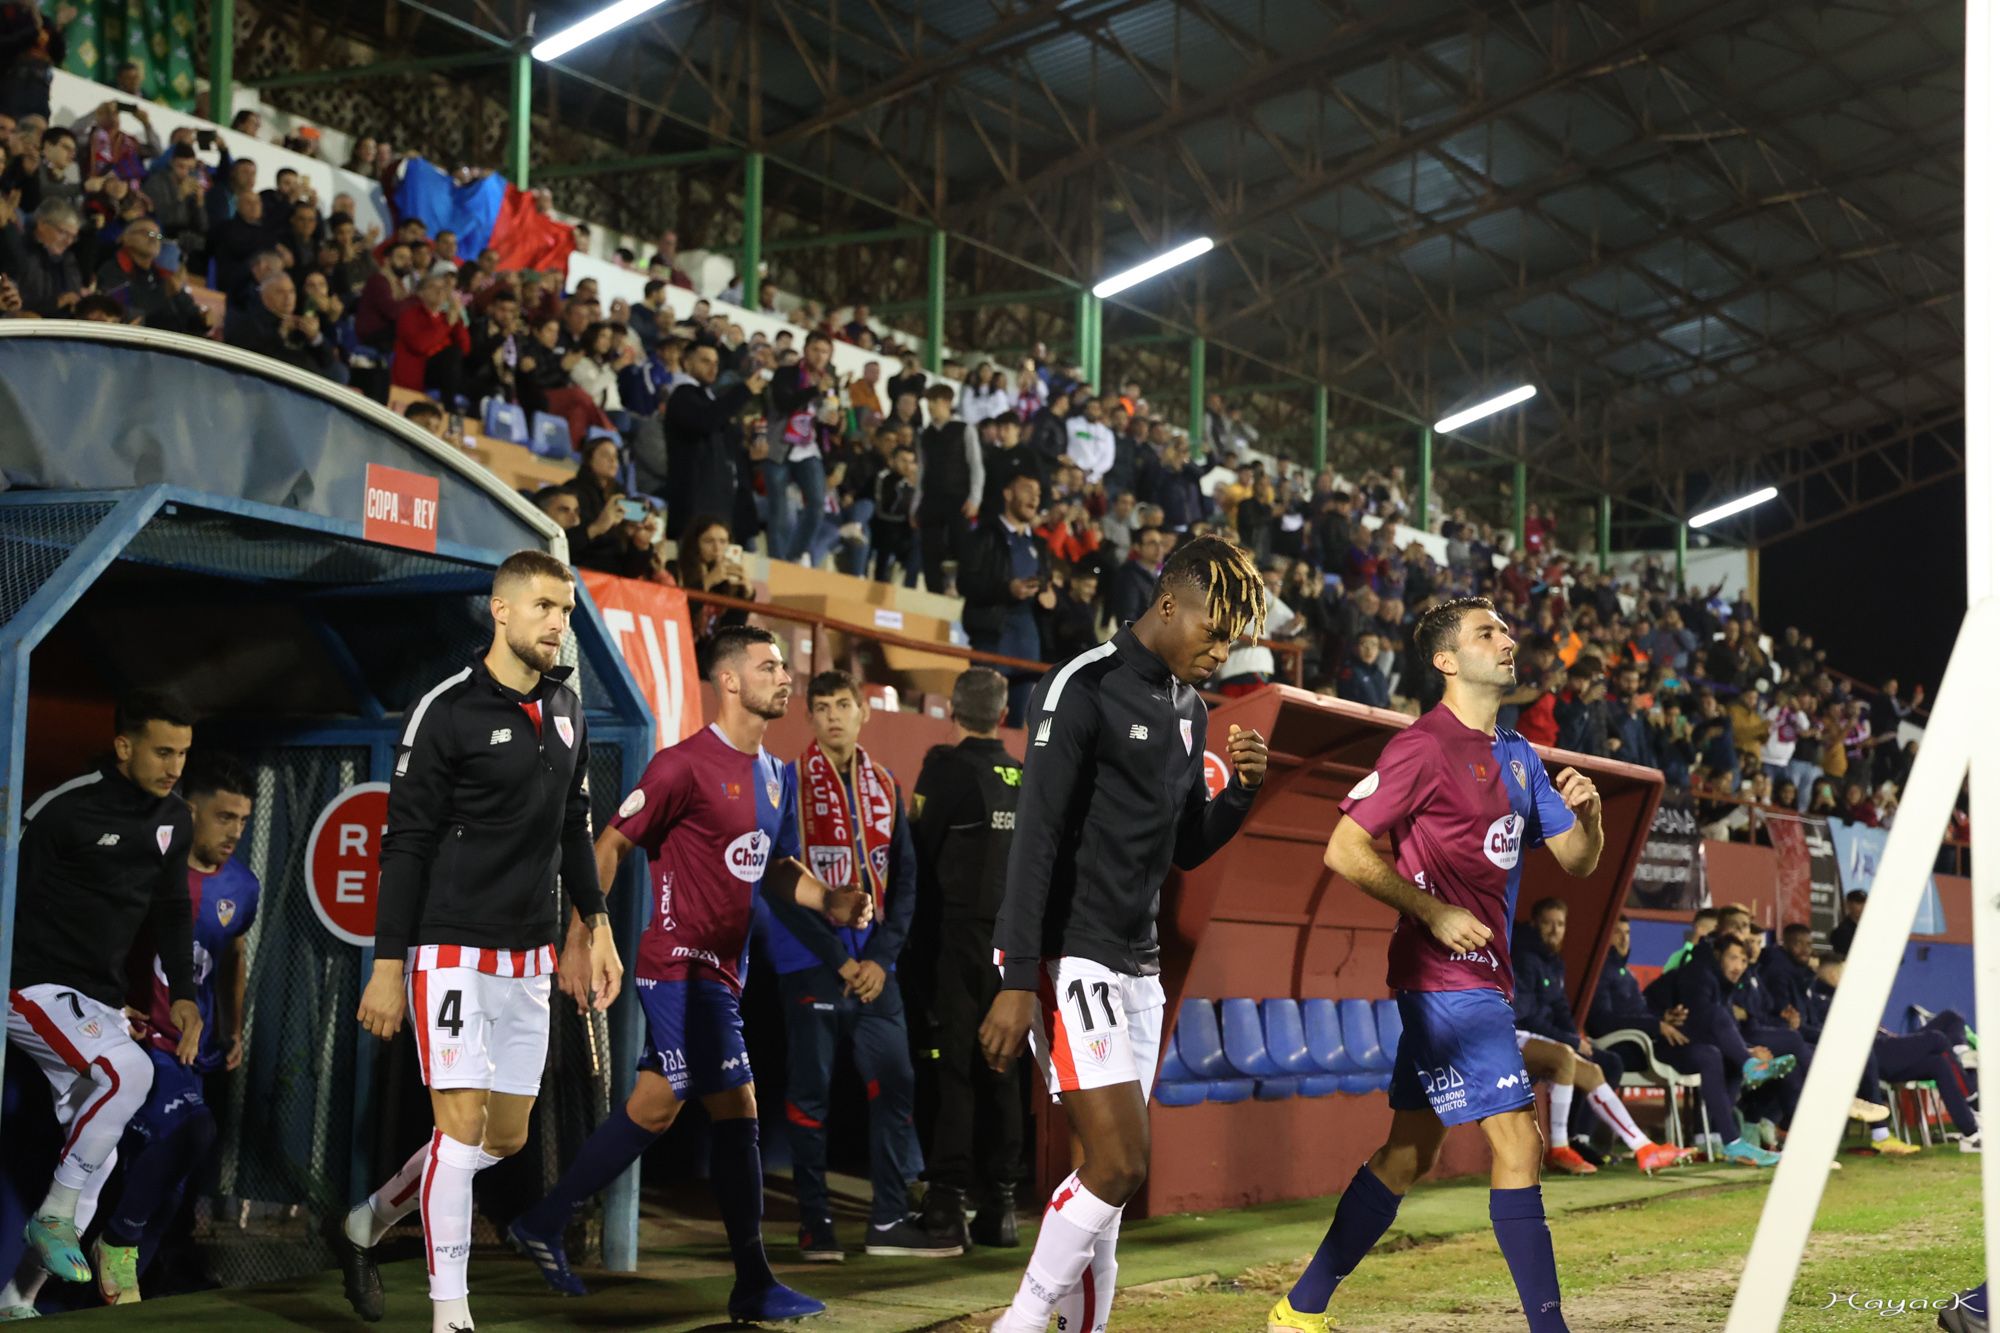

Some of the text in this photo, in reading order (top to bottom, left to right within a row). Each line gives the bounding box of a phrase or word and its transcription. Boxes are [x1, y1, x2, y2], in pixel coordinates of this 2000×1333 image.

[367, 487, 436, 530] COPA REY
[56, 992, 84, 1018] 7
[435, 990, 463, 1038] 4
